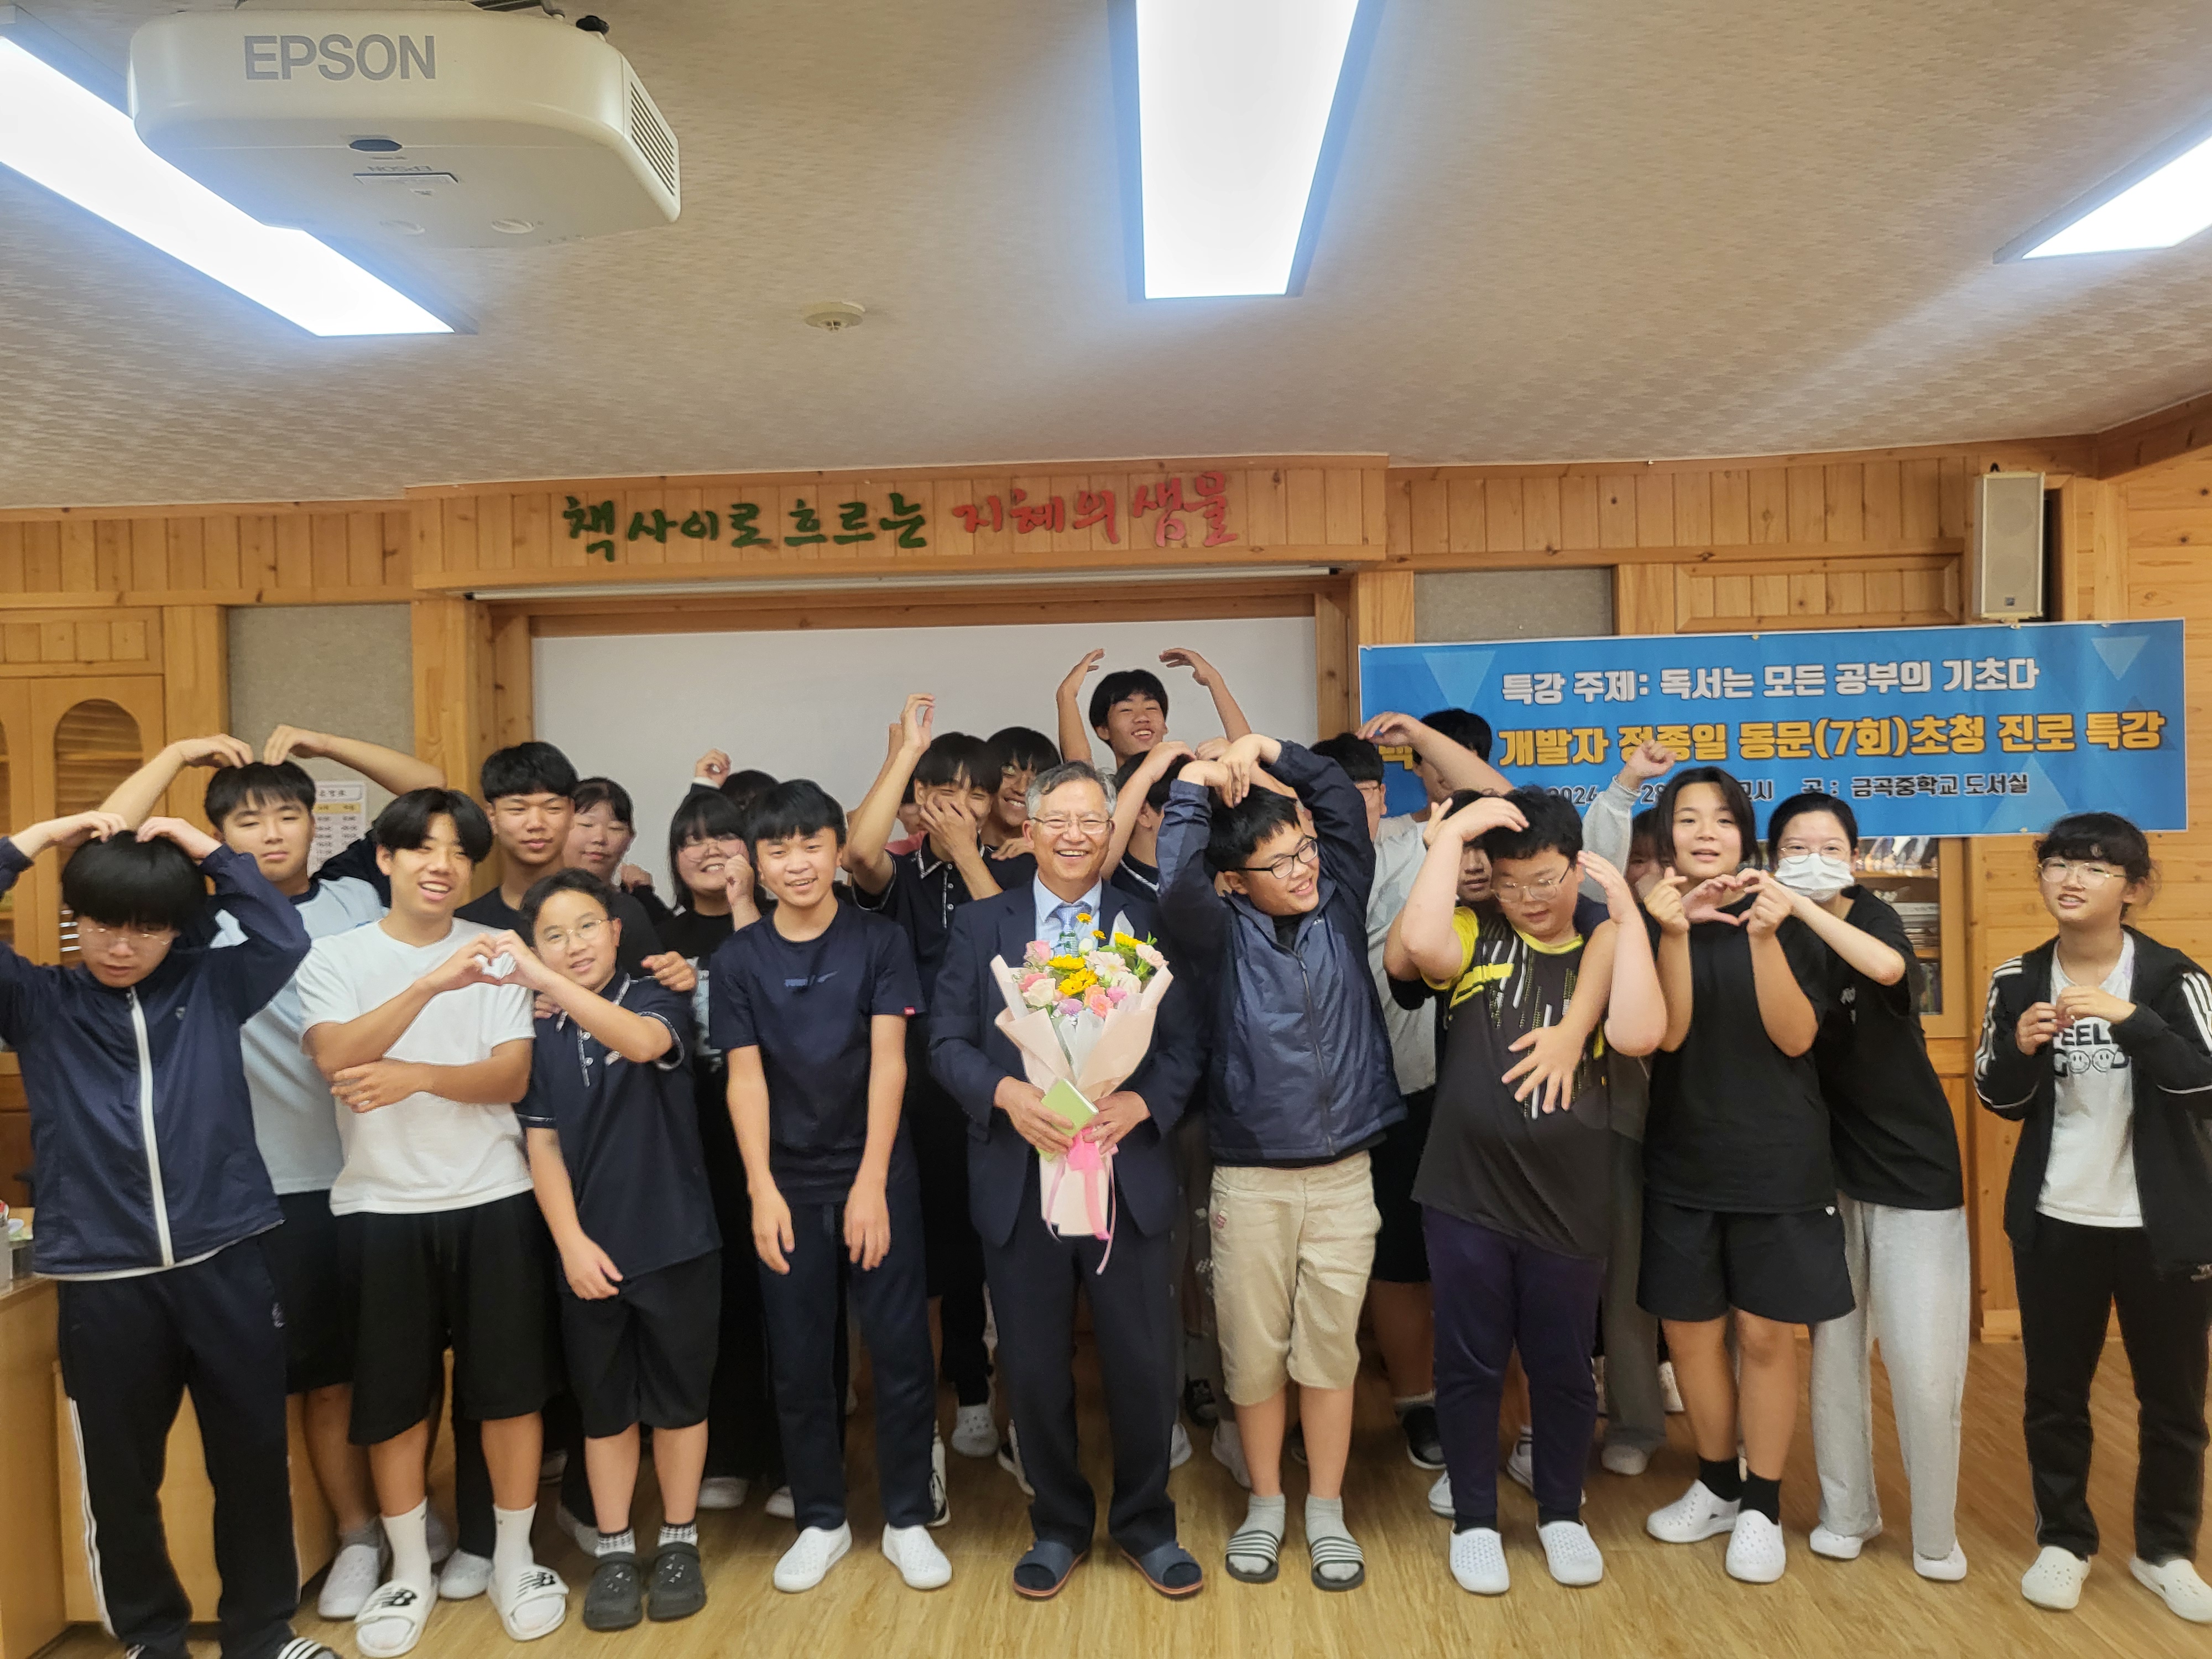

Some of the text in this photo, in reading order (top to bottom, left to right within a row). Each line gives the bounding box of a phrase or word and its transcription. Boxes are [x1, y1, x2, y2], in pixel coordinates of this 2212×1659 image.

[244, 35, 436, 81] EPSON
[563, 472, 1238, 562] 책 사이로 흐르는 지혜의 샘물
[1502, 657, 2041, 706] 특강 주제: 독서는 모든 공부의 기초다
[1499, 728, 1610, 766] 개발자
[1738, 714, 1987, 759] 동문(7회)초청
[1998, 714, 2077, 753] 진로
[2086, 711, 2166, 750] 특강
[1851, 774, 1960, 798] 금곡중학교
[1963, 772, 2031, 796] 도서실
[2053, 1022, 2110, 1046] EEL
